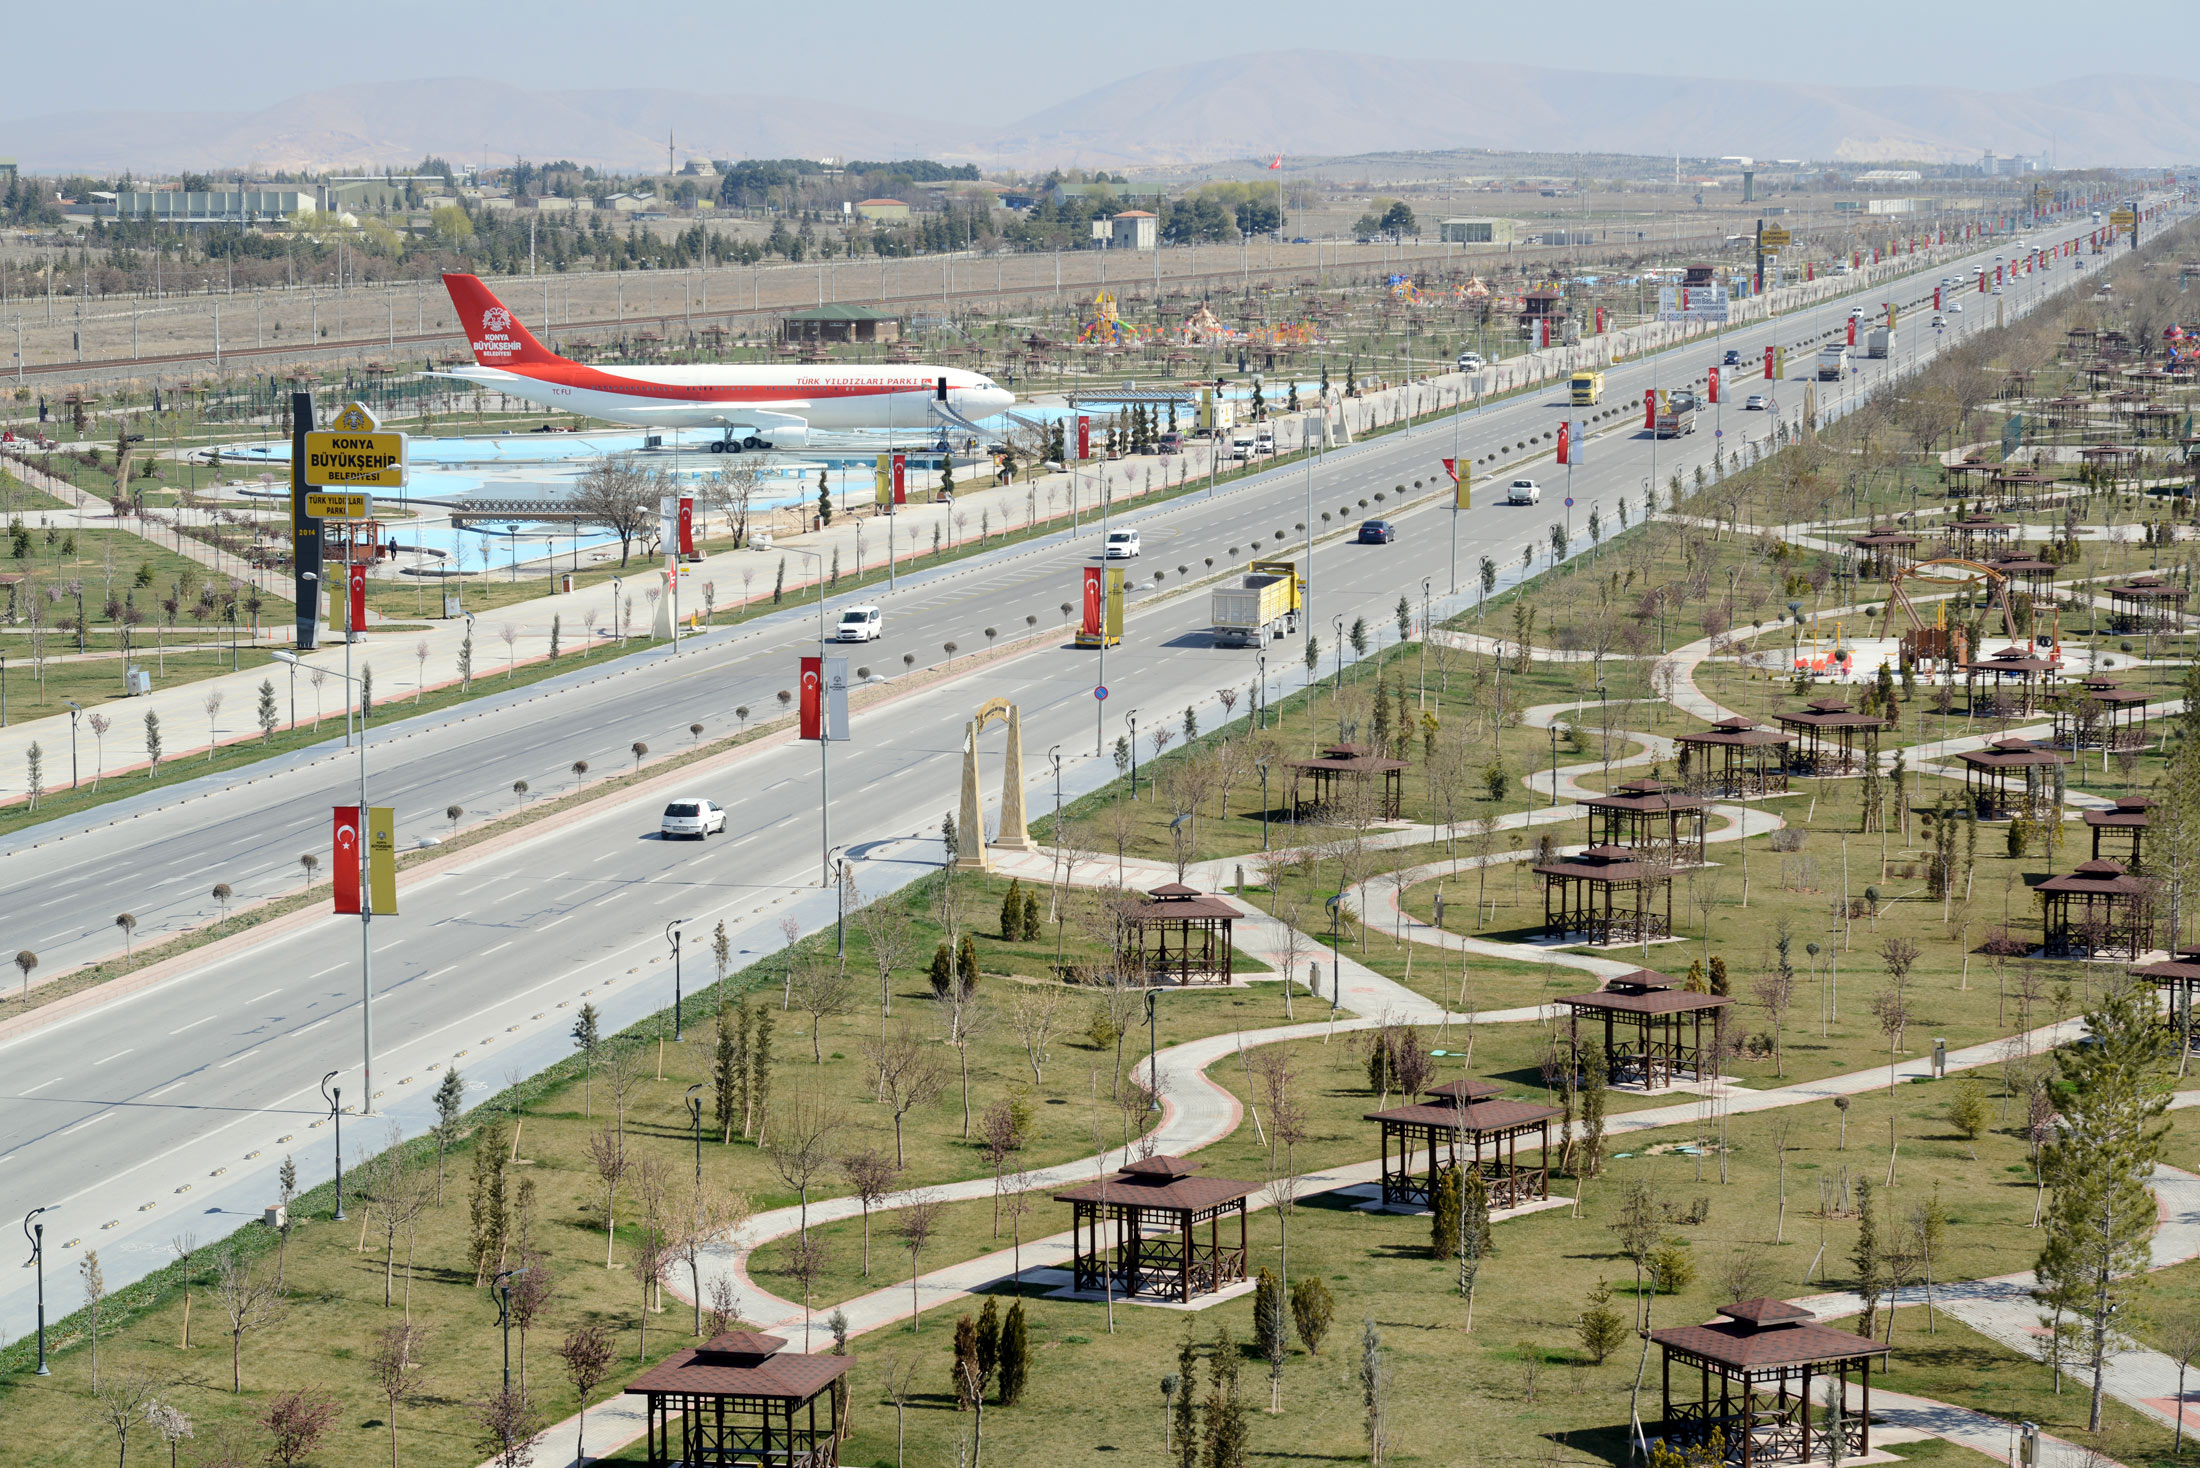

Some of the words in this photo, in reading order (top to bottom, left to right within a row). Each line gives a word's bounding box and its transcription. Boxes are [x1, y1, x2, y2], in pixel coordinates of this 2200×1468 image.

[473, 341, 522, 351] BÜYÜKŞEHİR
[797, 376, 820, 385] TÜRK
[332, 439, 374, 450] KONYA
[311, 452, 396, 471] BÜYÜKŞEHİR
[309, 495, 326, 505] TÜRK
[328, 496, 363, 505] YILDILARI
[326, 507, 346, 515] PARKI
